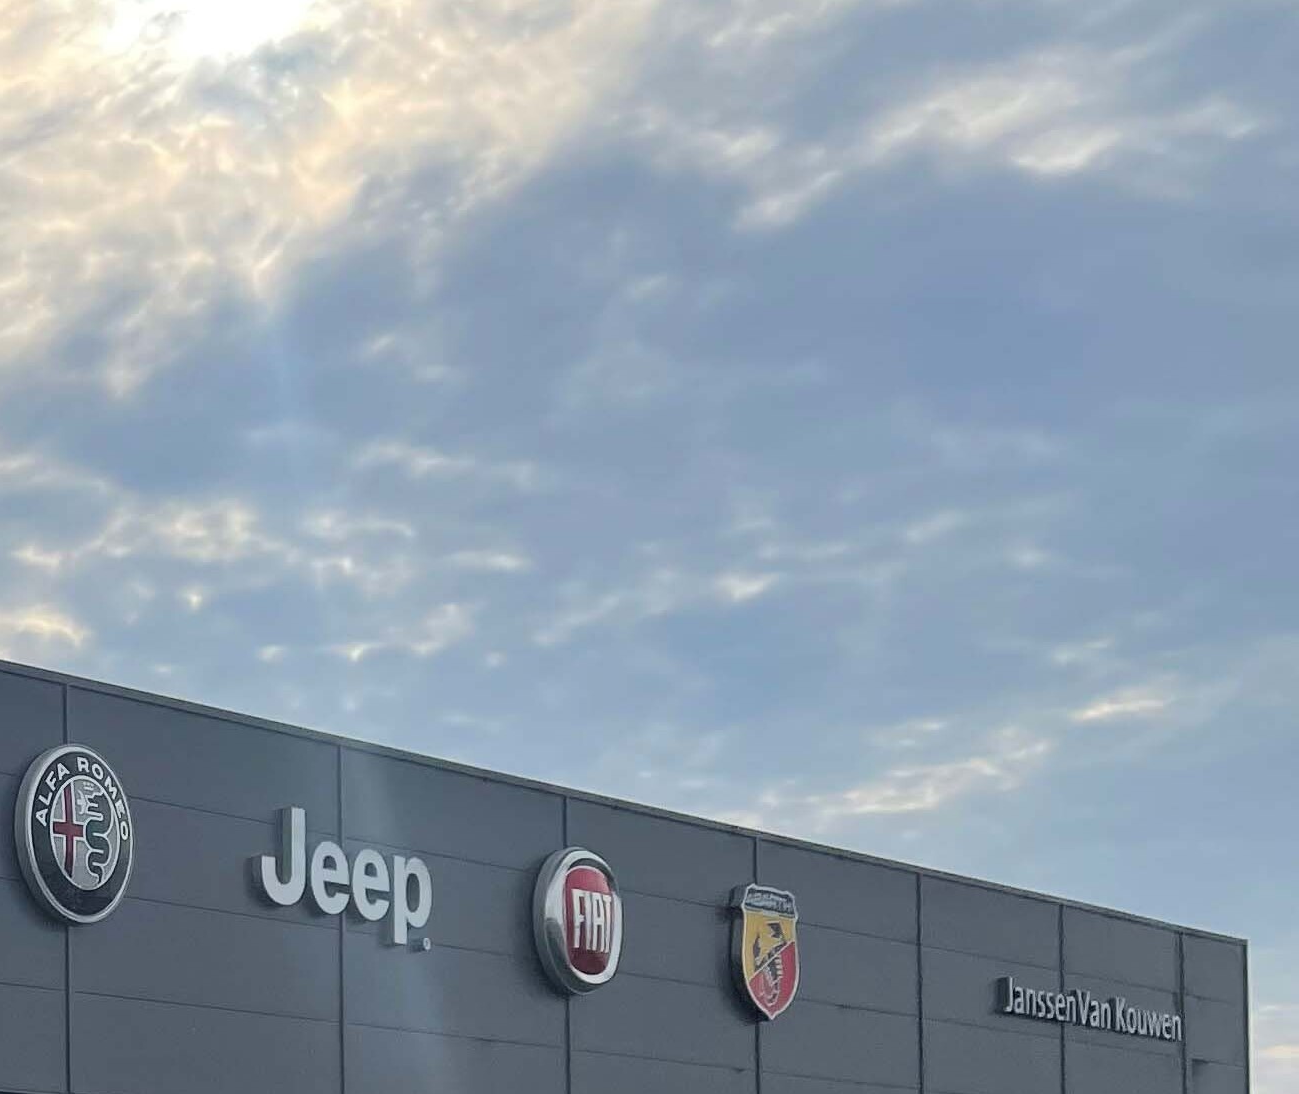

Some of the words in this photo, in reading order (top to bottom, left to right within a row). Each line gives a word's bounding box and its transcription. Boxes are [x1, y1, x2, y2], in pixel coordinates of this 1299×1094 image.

[35, 762, 71, 827] ALFA
[76, 756, 130, 841] ROMEO
[260, 806, 433, 946] Jeep
[571, 888, 612, 954] FIAT
[1004, 976, 1077, 1024] Janssen
[1075, 988, 1113, 1030] Van
[1114, 995, 1183, 1042] Kouwen
